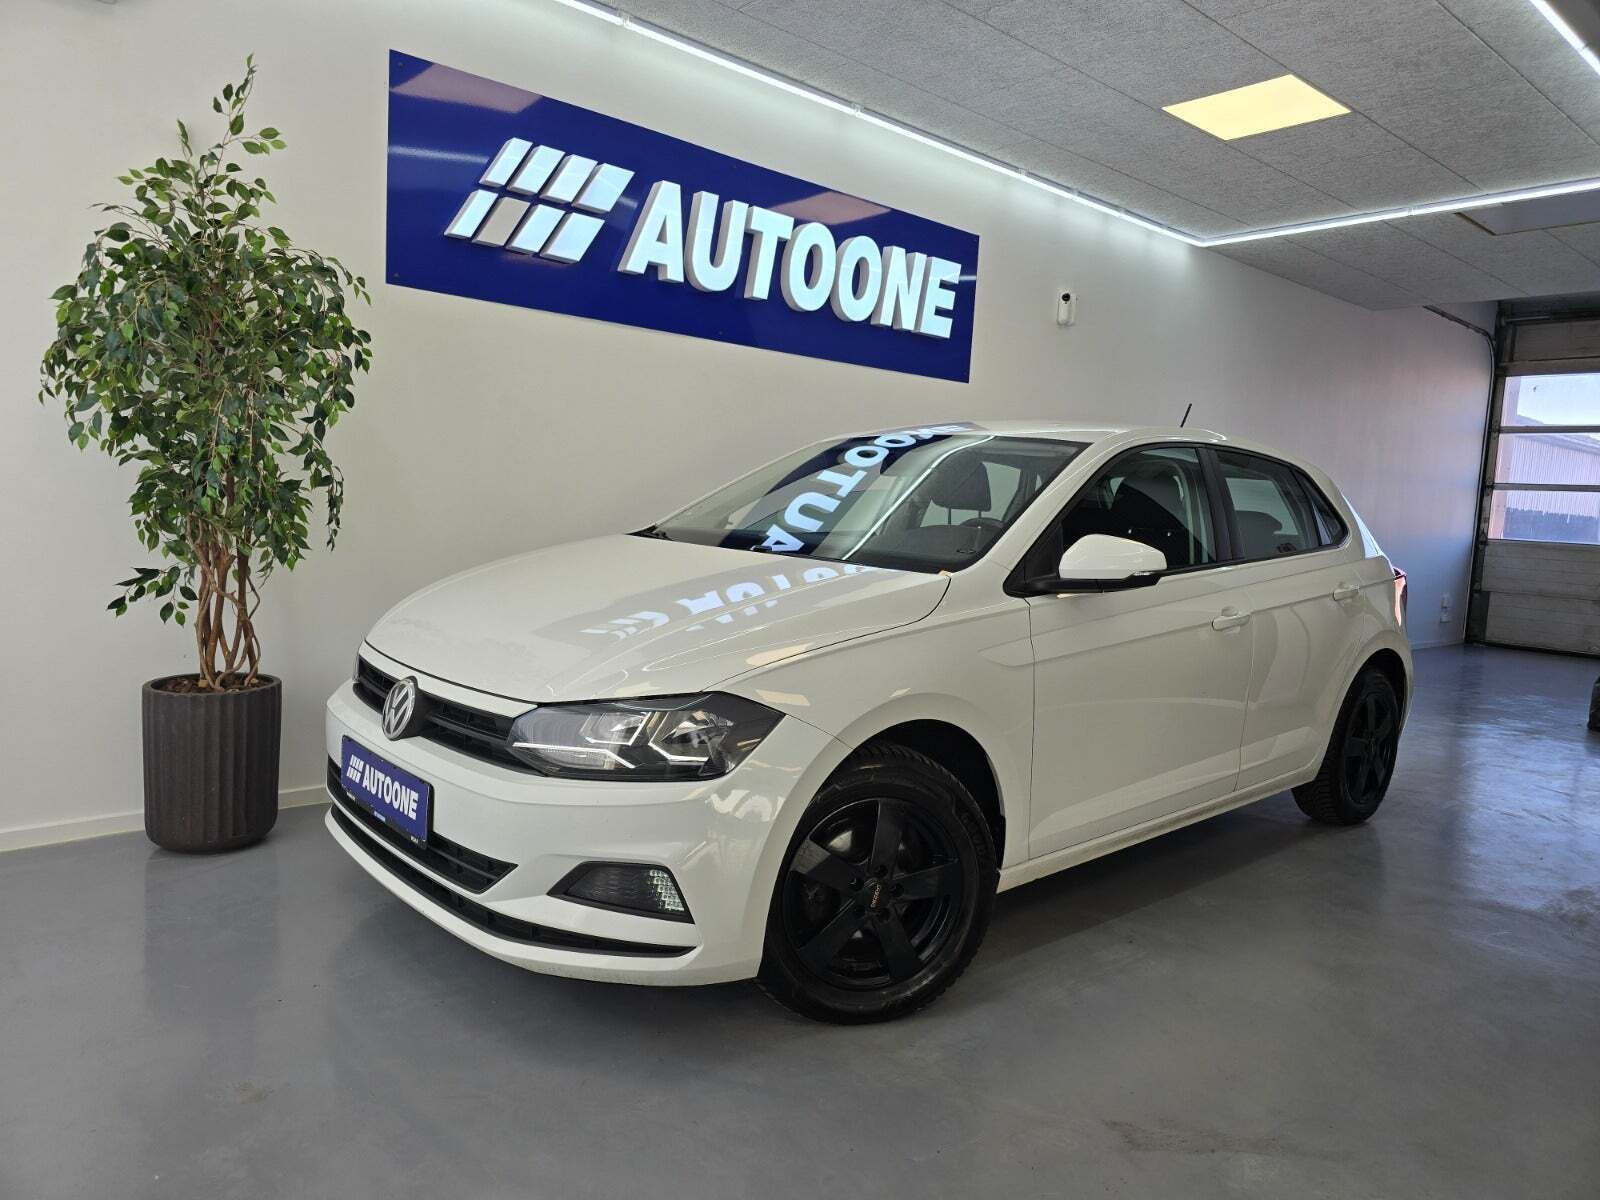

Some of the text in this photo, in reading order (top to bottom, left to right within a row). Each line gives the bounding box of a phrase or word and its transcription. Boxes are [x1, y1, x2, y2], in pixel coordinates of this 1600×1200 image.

[617, 180, 962, 339] AUTOONE
[384, 681, 413, 737] VW
[362, 764, 419, 820] AUTOONE
